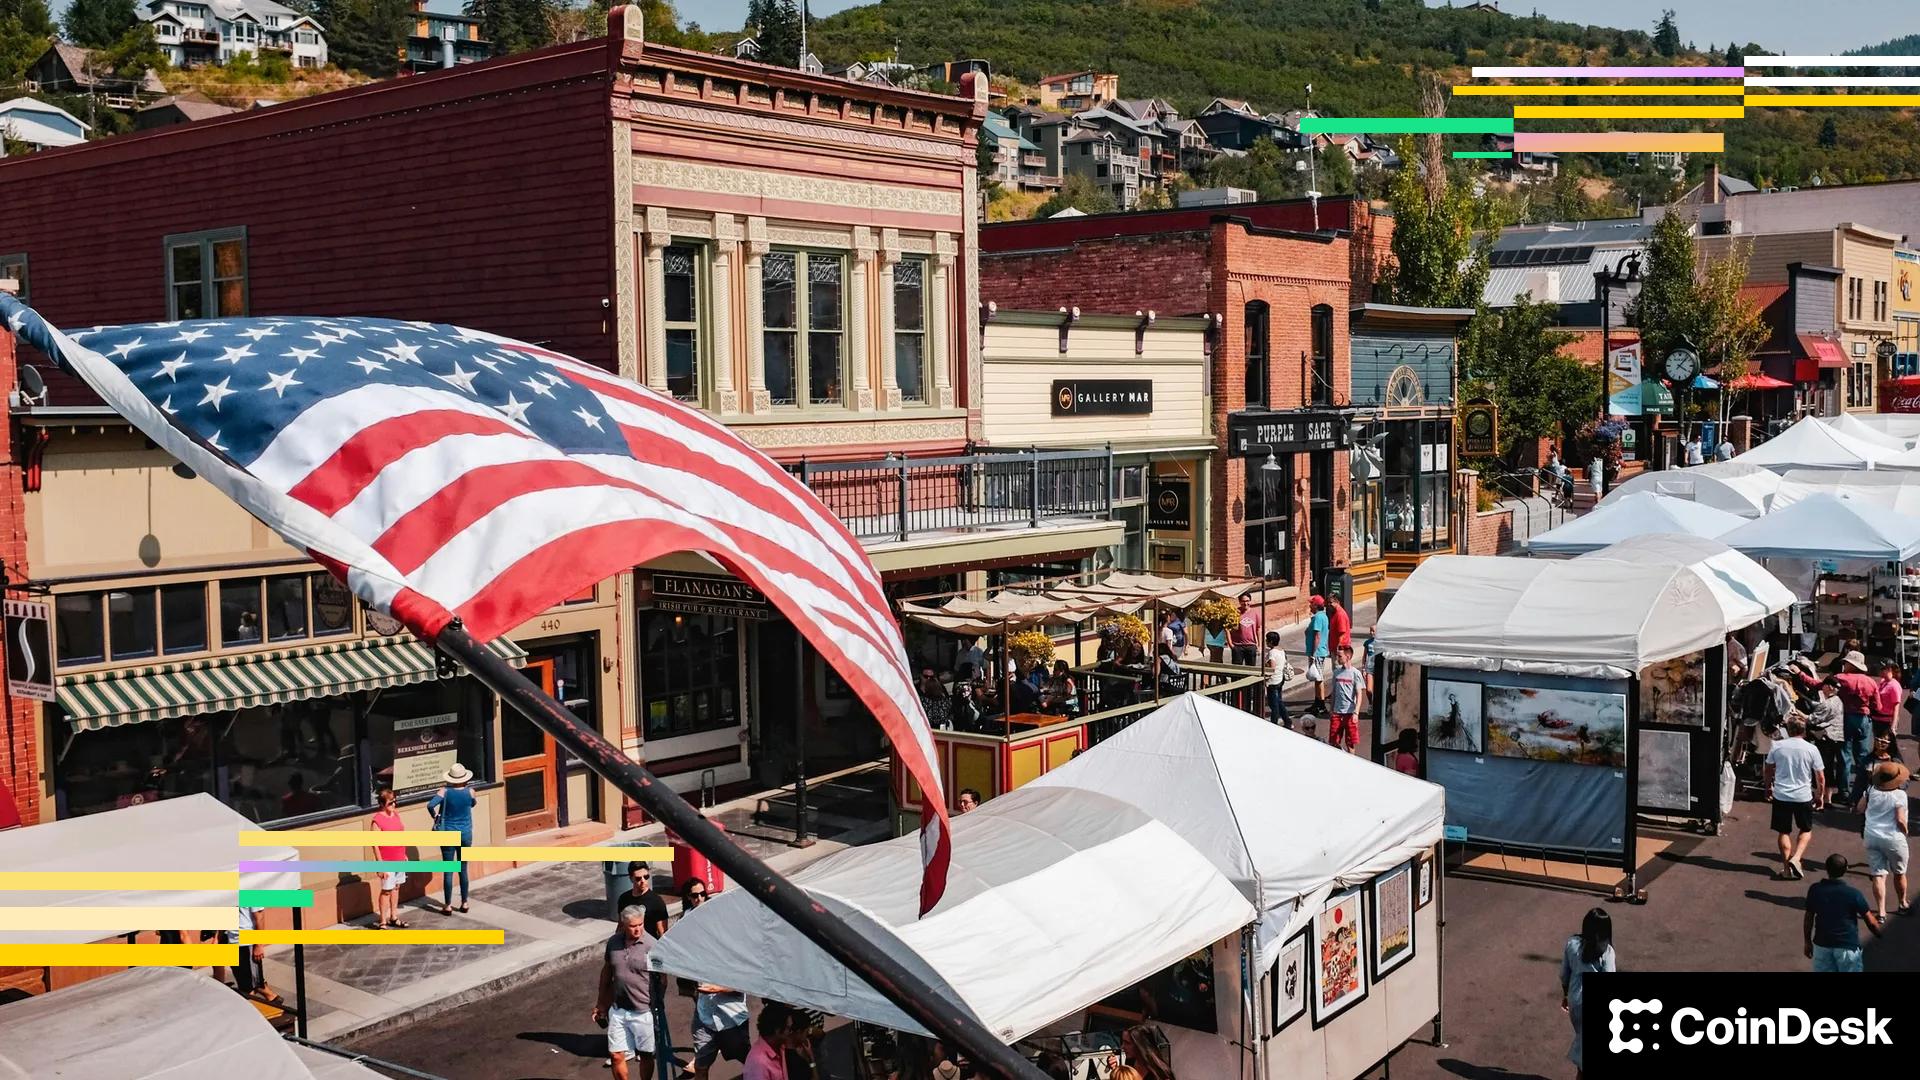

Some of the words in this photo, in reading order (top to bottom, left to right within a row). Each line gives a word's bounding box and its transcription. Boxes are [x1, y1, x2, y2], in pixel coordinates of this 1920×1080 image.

[1078, 393, 1125, 403] GALLERY
[1129, 392, 1149, 402] MAR
[1257, 424, 1294, 443] PURPLE
[1308, 422, 1332, 440] SAGE
[664, 579, 753, 599] FLANAGAN'S
[661, 602, 681, 611] IRISH
[682, 603, 698, 612] PUB
[708, 606, 761, 618] RESTAURANT
[541, 619, 560, 631] 440
[397, 743, 427, 754] BERKSHIRE
[428, 740, 454, 749] HATHAWAY
